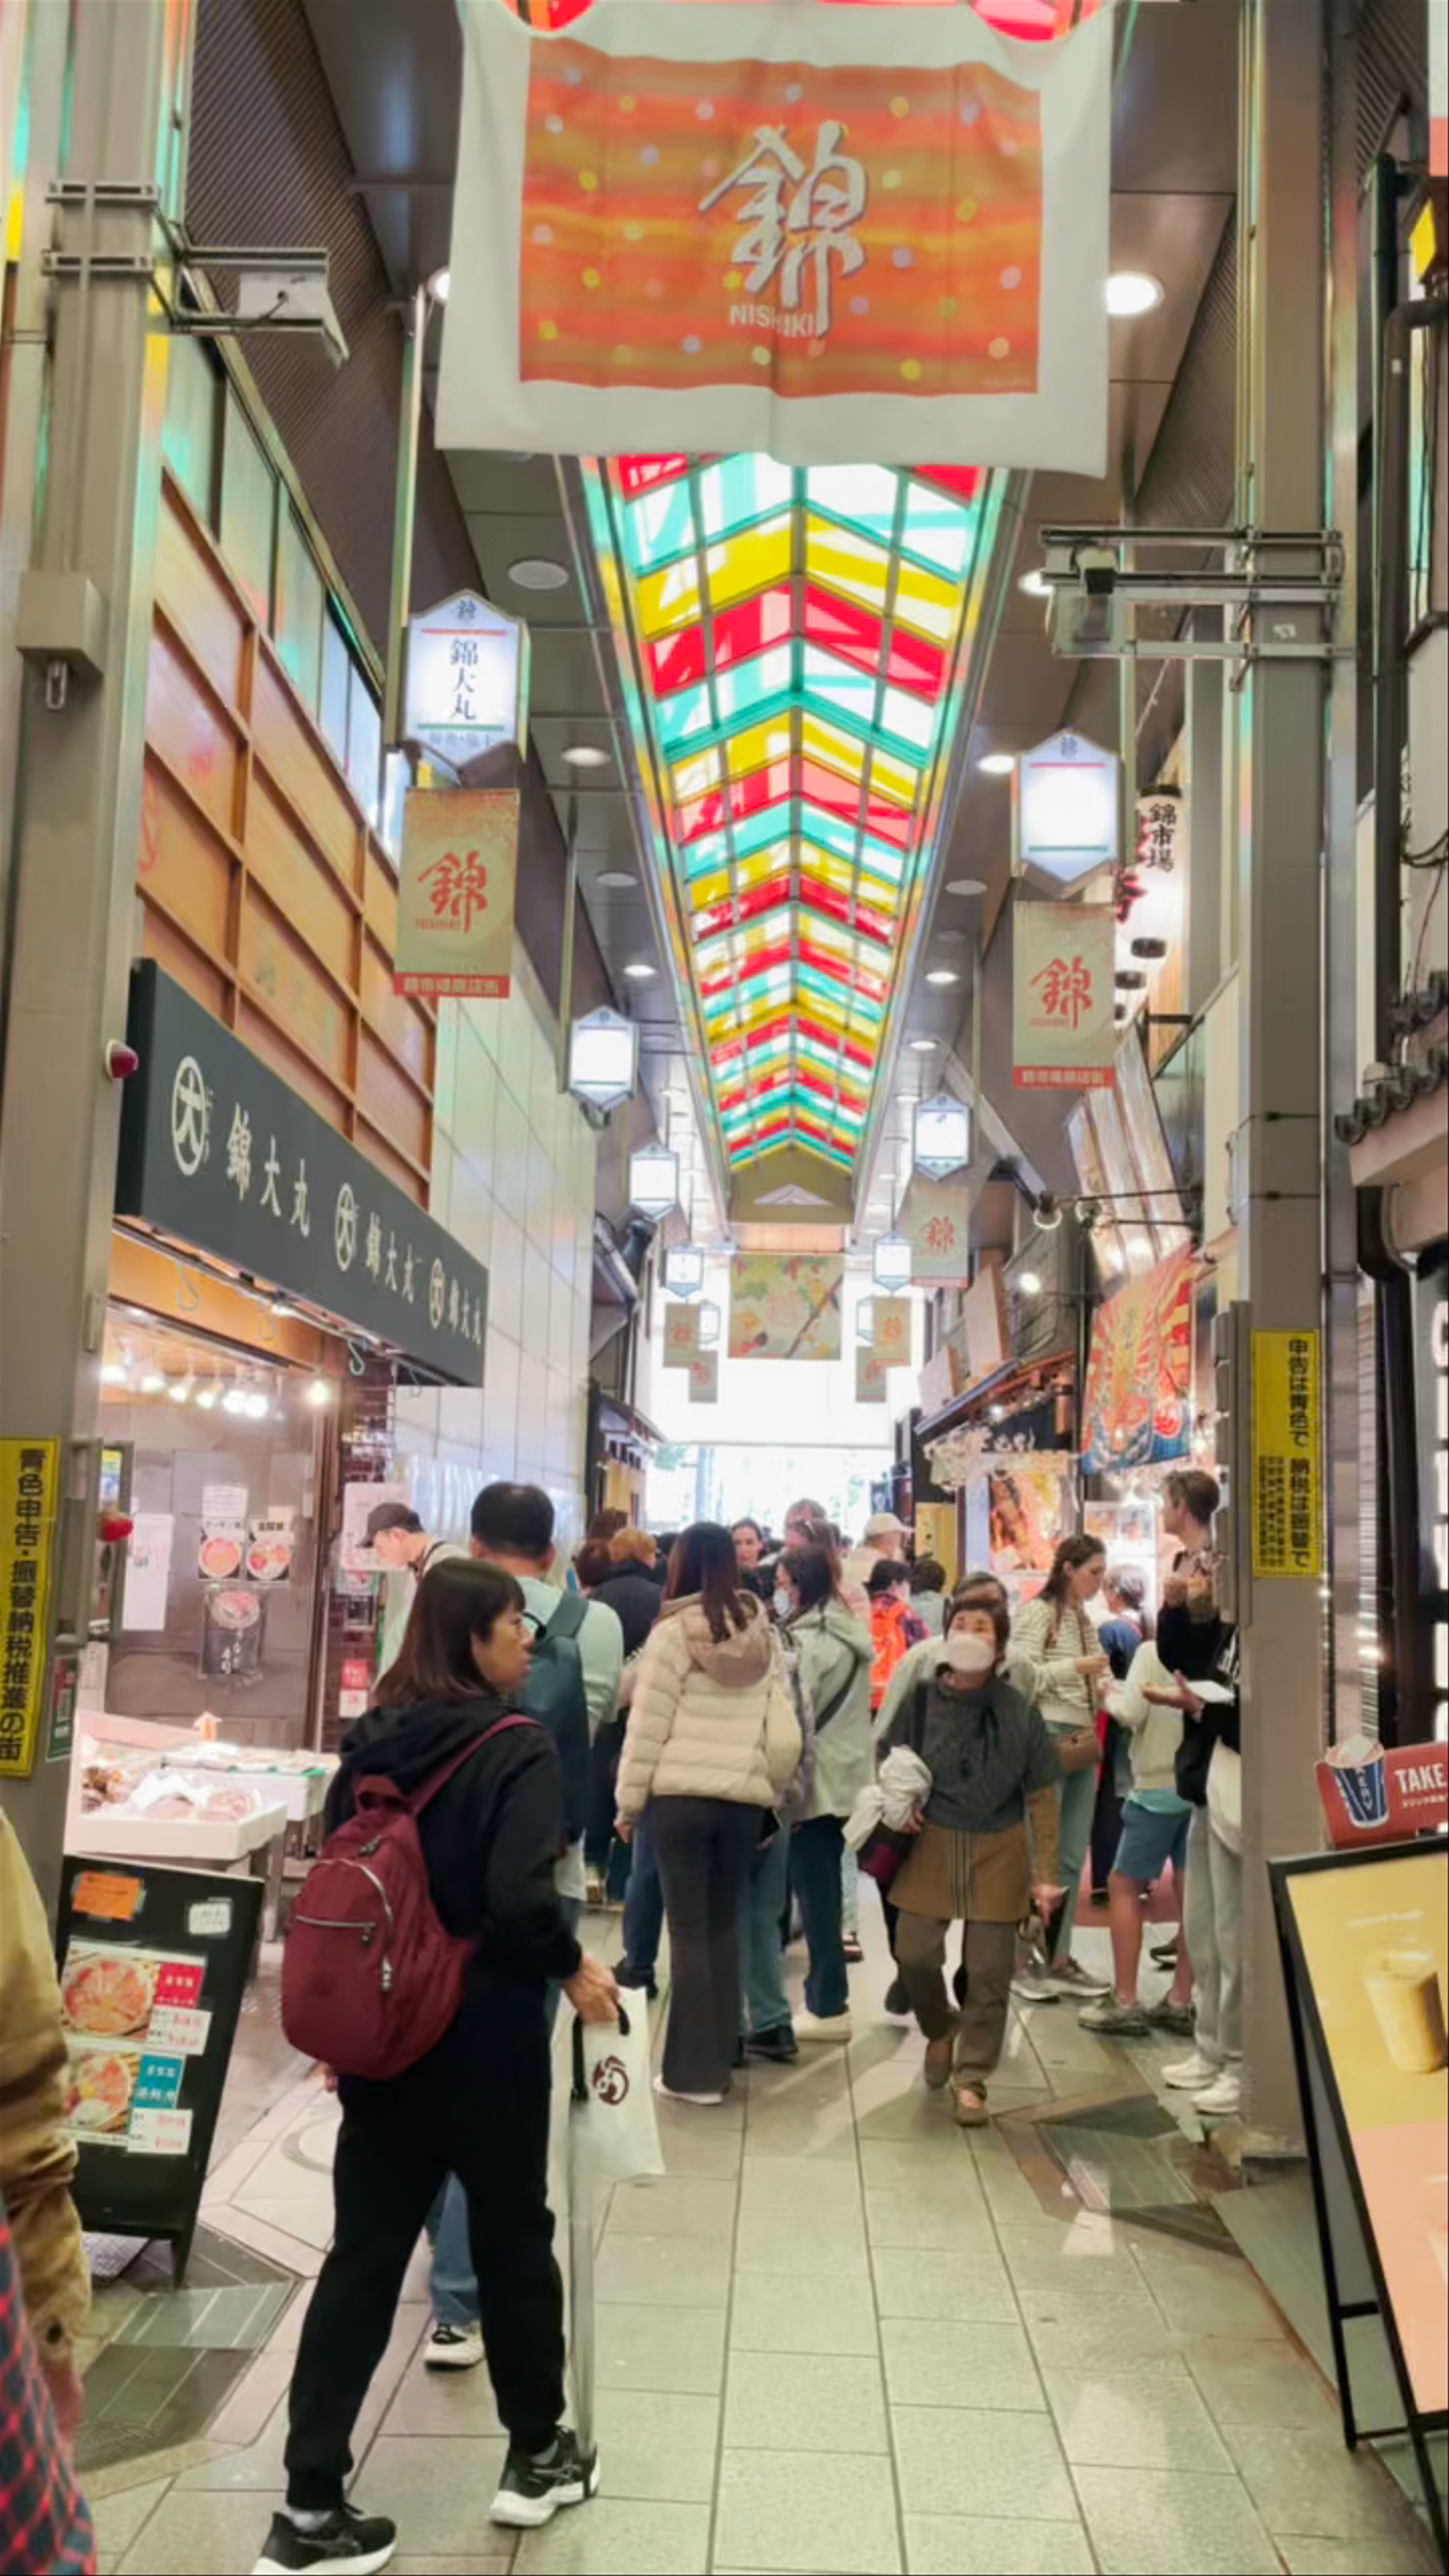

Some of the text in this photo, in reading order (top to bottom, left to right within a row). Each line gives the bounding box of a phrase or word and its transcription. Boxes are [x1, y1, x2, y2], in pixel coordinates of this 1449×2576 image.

[699, 120, 866, 338] 錦
[728, 304, 816, 338] NISHIKI
[449, 639, 478, 721] 錦大丸
[1146, 804, 1177, 873] 錦市場
[417, 849, 487, 934] 錦
[1029, 956, 1092, 1030] 錦
[227, 1103, 309, 1238] 錦大丸
[365, 1210, 414, 1304] 錦大丸
[1394, 1762, 1447, 1795] TAKE
